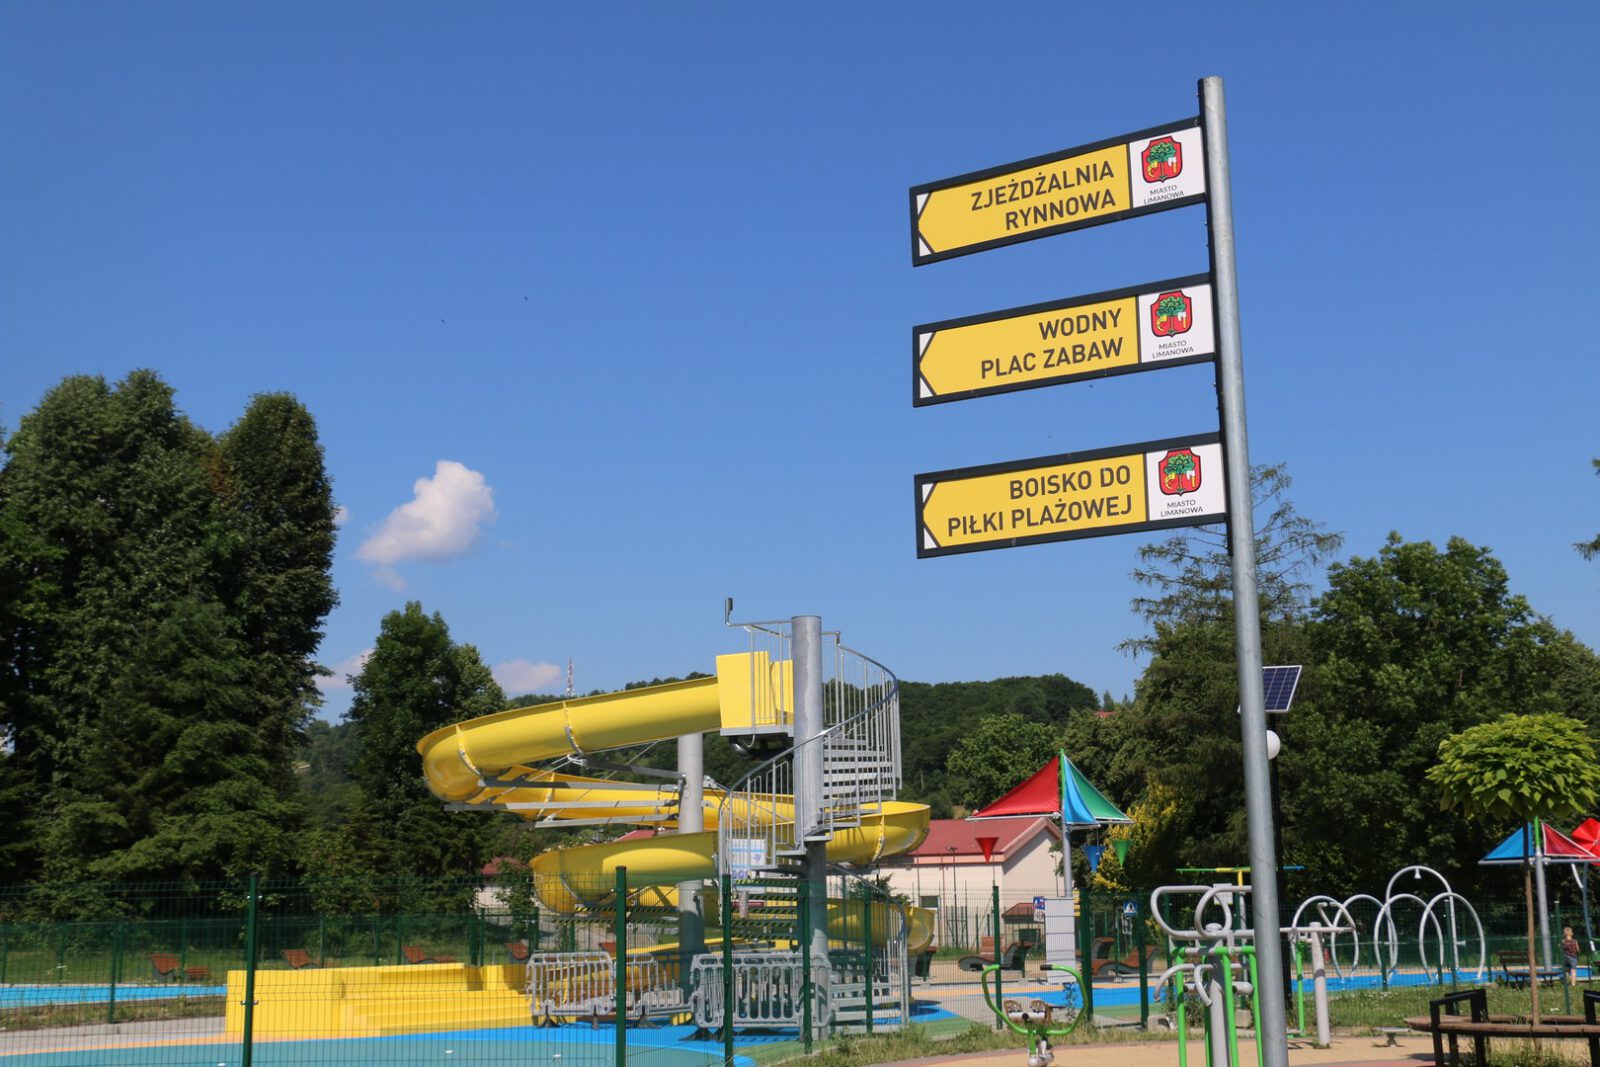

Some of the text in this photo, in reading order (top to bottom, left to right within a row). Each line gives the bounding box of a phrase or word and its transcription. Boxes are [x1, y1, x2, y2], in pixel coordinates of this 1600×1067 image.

[971, 160, 1114, 211] ZJEŻDŻALNIA
[1143, 190, 1185, 204] LIMANOWA
[1150, 184, 1178, 196] MIASTO
[1005, 188, 1116, 230] RYNNOWA
[1038, 308, 1121, 340] WODNY
[1152, 346, 1194, 359] LIMANOWA
[1158, 340, 1187, 351] MIASTO
[981, 337, 1123, 379] PLAC ZABAW
[1009, 465, 1131, 500] BOISKO DO
[948, 494, 1132, 537] PIŁKI PLAŻOWEJ
[1160, 506, 1204, 518] LIMANOWA
[1166, 499, 1196, 509] MIASTO
